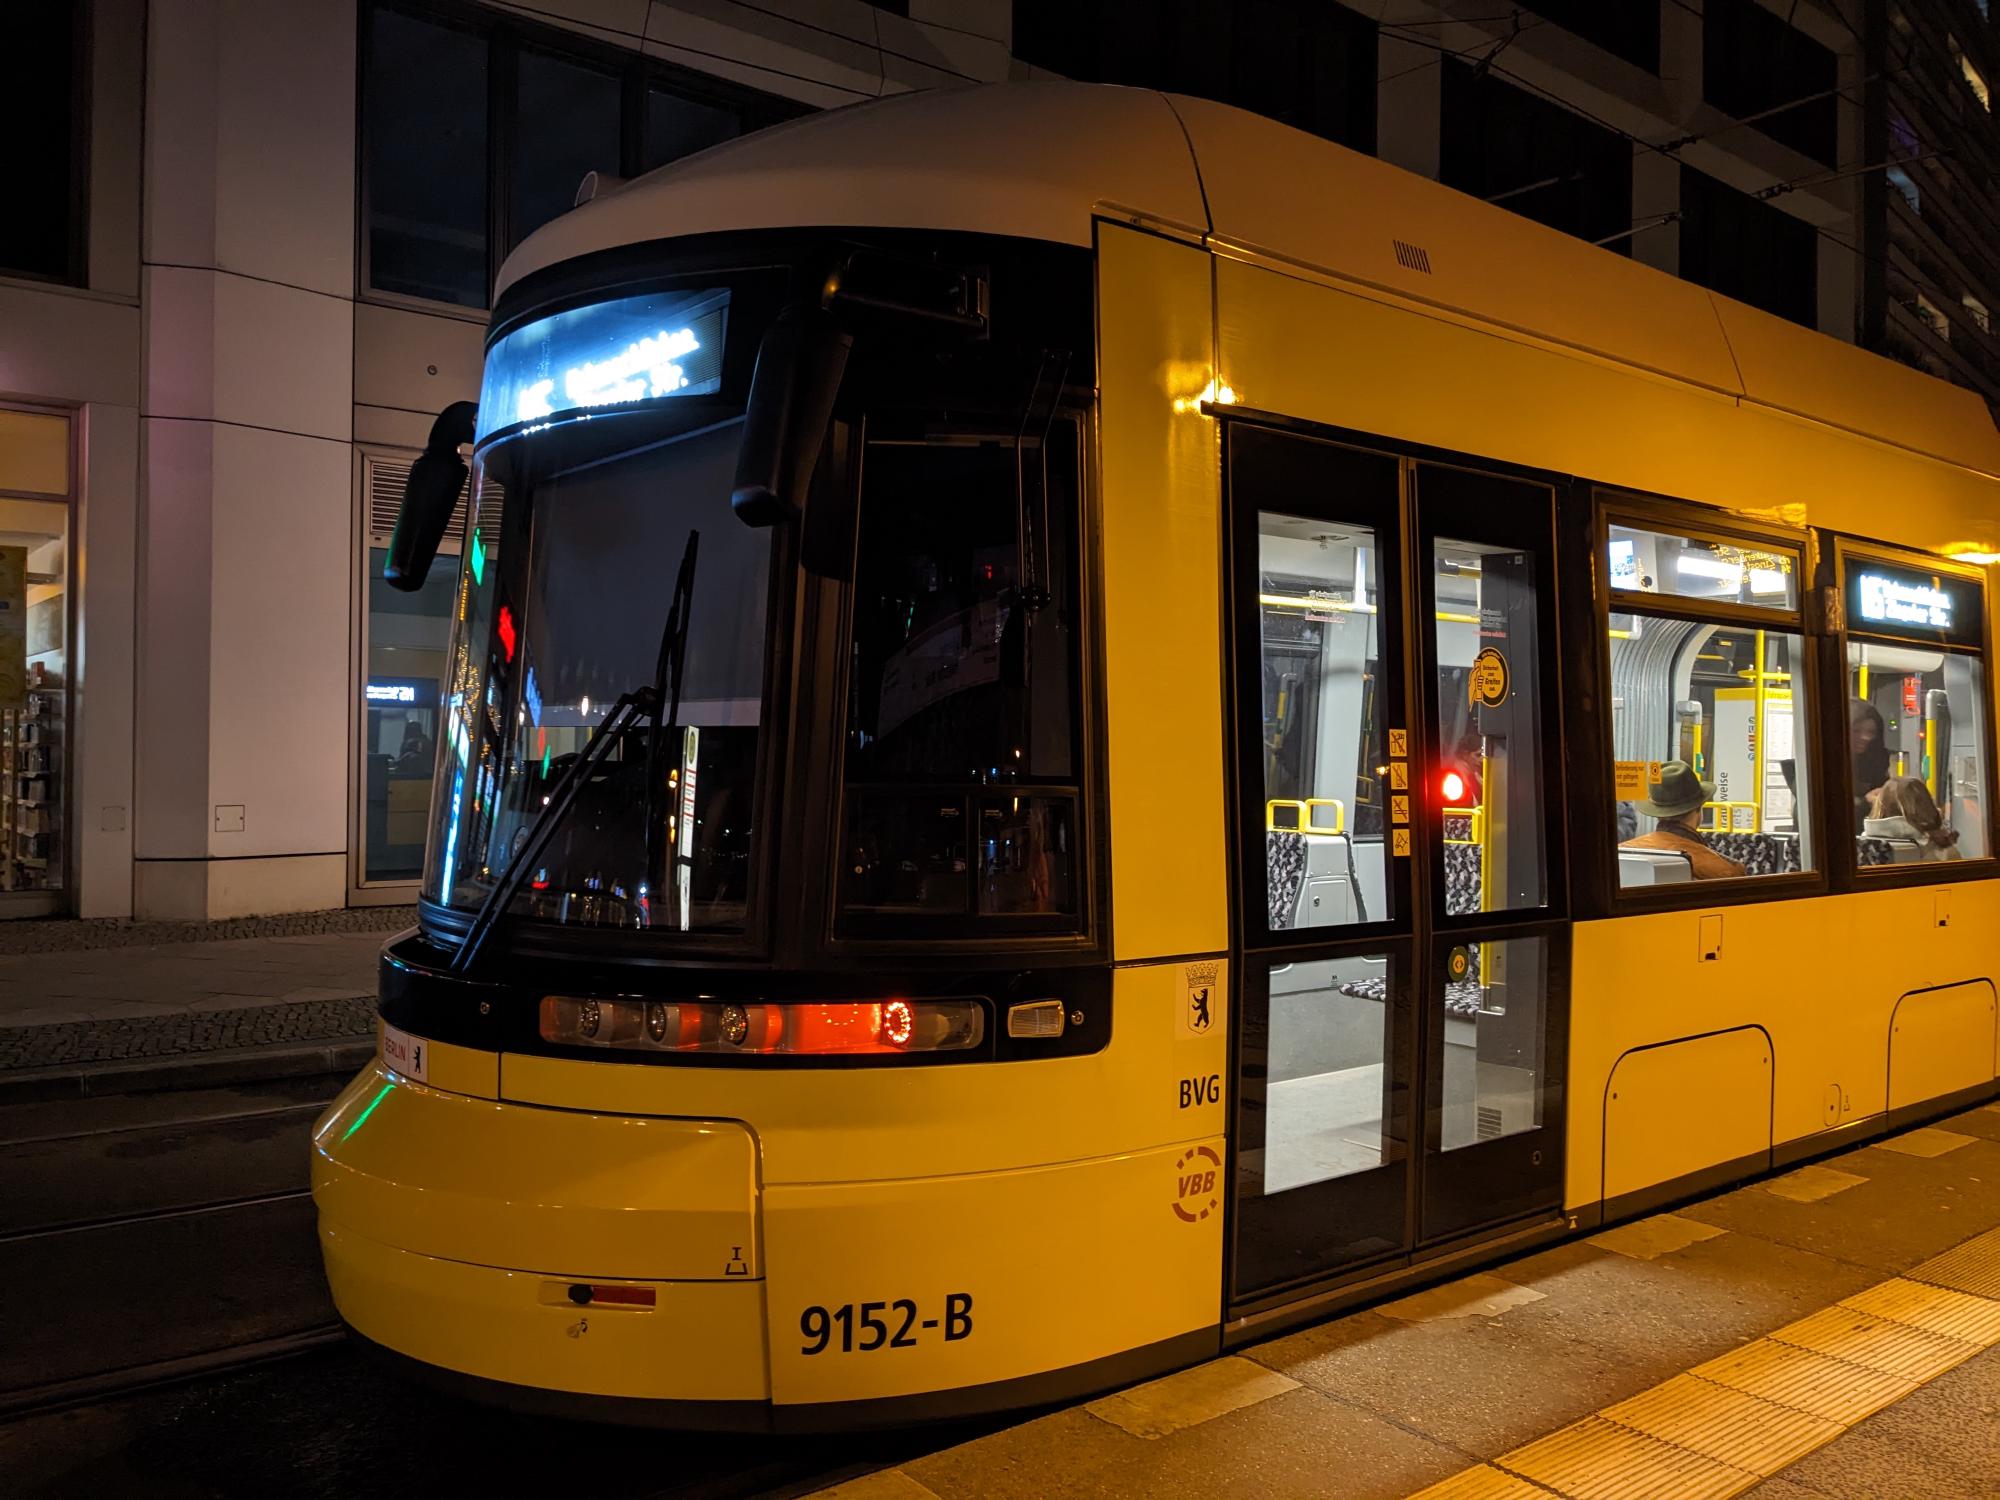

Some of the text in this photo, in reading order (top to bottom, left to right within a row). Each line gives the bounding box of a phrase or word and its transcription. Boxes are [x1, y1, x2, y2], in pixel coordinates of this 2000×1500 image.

[385, 1035, 406, 1062] BERLIN
[1179, 1074, 1220, 1109] BVG
[1178, 1170, 1216, 1199] VBB
[800, 1292, 973, 1356] 9152-B
